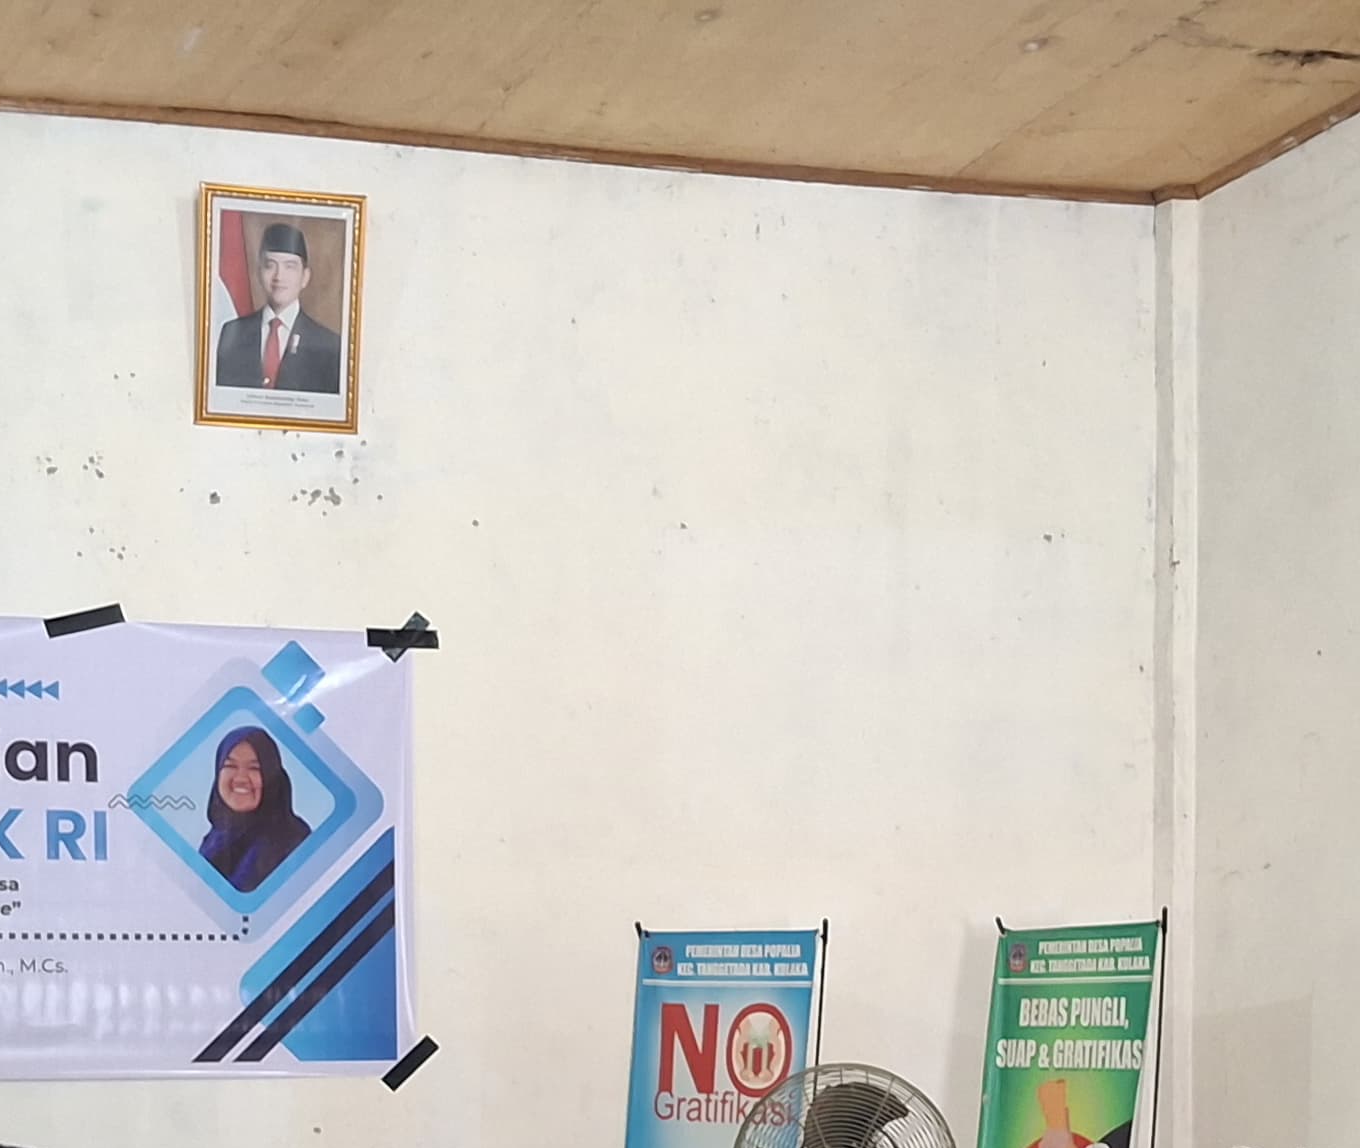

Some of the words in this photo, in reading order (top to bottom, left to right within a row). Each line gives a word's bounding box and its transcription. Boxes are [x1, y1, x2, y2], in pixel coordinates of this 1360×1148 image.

[46, 808, 108, 862] RI
[20, 957, 69, 974] M.Cs.
[1018, 998, 1068, 1028] BEBAS
[1070, 996, 1129, 1030] PUNGLI,
[658, 1002, 793, 1098] NO
[995, 1038, 1037, 1068] SUAP
[1038, 1043, 1050, 1068] &
